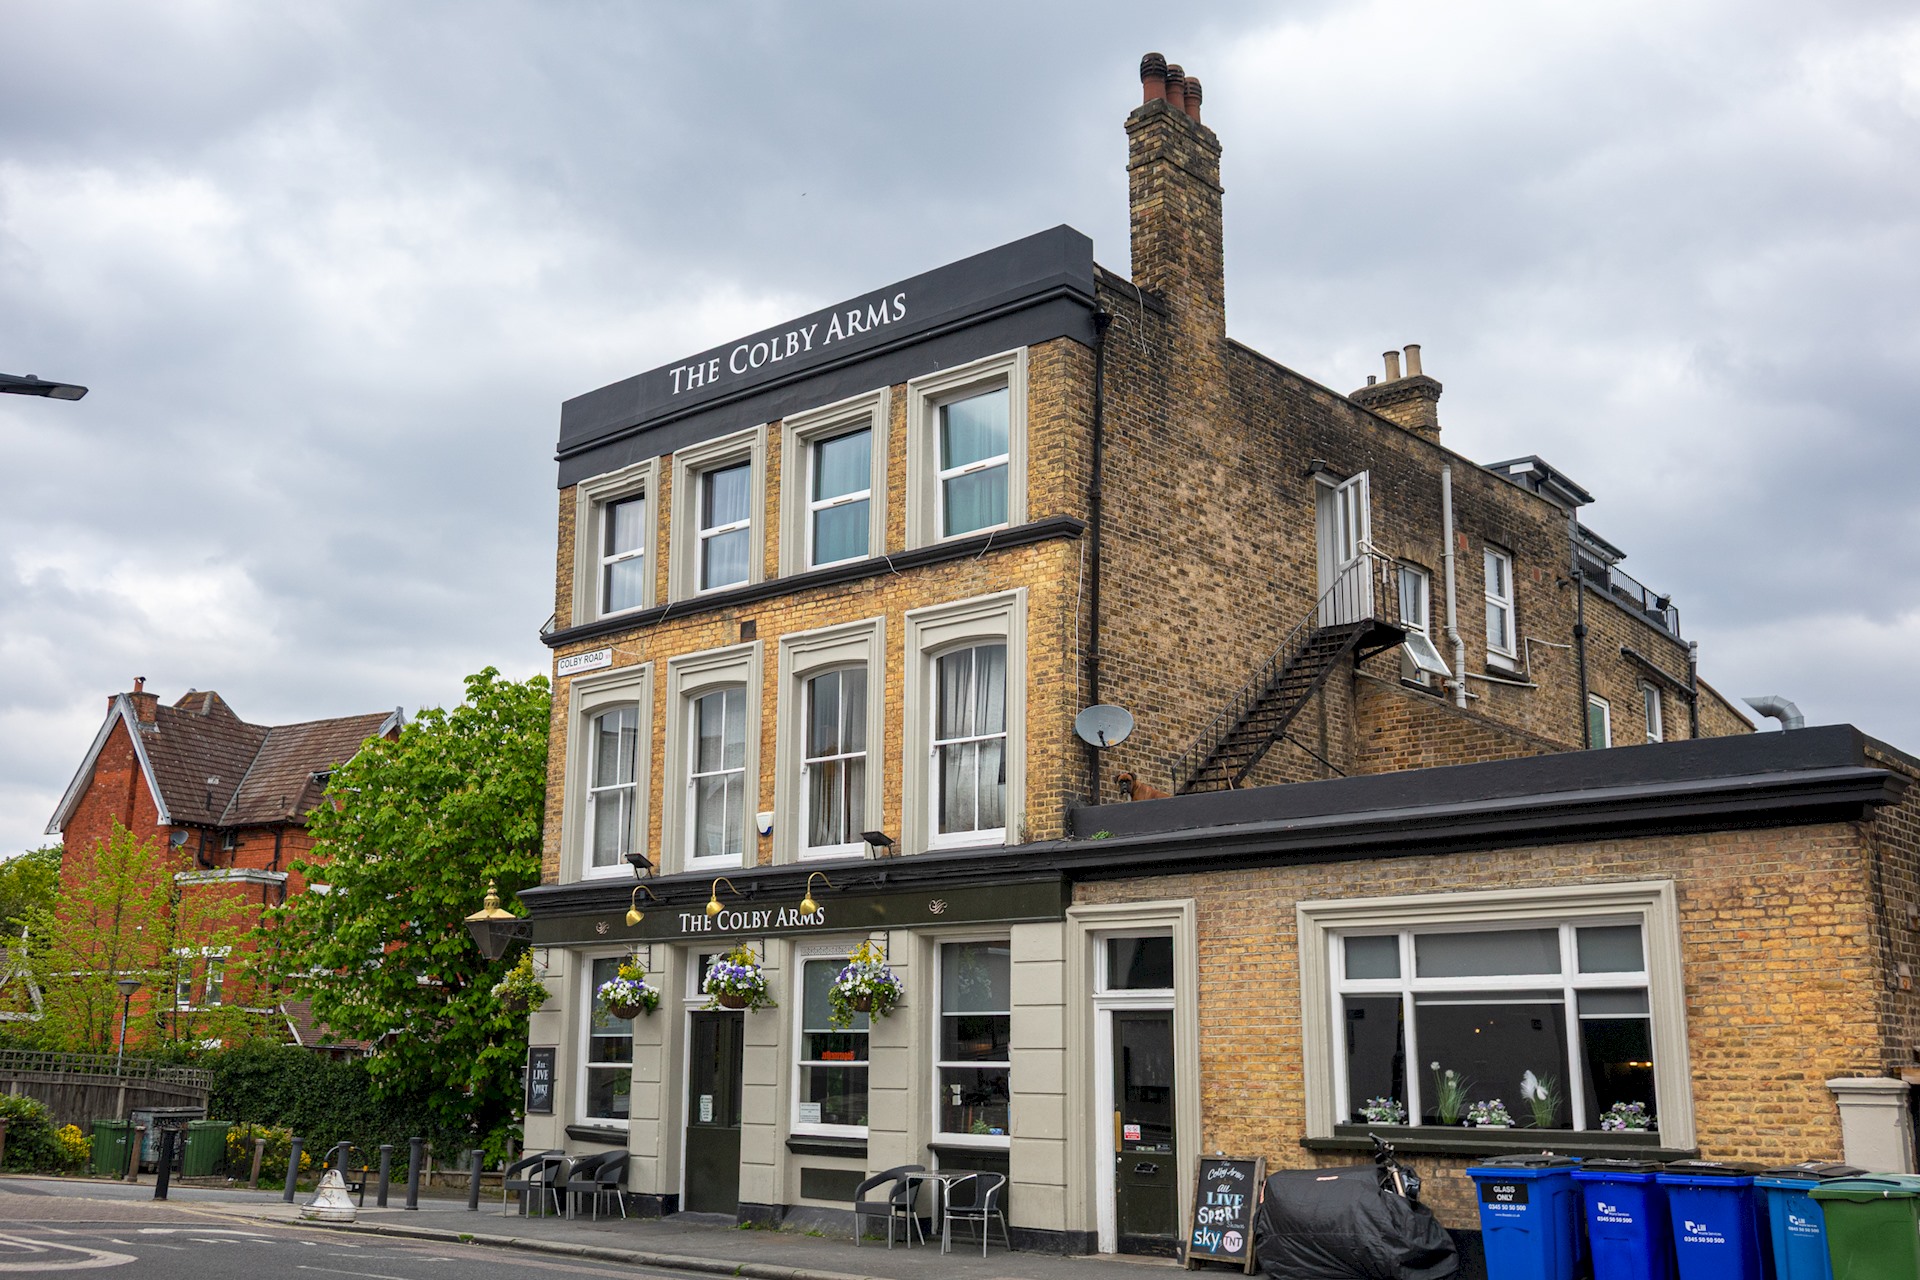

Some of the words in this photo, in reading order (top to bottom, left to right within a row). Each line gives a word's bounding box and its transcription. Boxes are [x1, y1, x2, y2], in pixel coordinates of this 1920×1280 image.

[669, 358, 720, 395] THE
[729, 323, 818, 374] COLBY
[823, 292, 906, 346] ARMS
[560, 656, 583, 669] COLBY
[584, 651, 604, 664] ROAD
[679, 913, 712, 932] THE
[717, 910, 772, 931] COLBY
[775, 906, 825, 928] ARMS
[532, 1069, 549, 1080] LIVE
[1207, 1167, 1227, 1180] Colby
[1226, 1167, 1245, 1181] Arms
[1206, 1191, 1244, 1206] LIVE
[1194, 1227, 1220, 1252] sky
[1224, 1236, 1242, 1247] TNT
